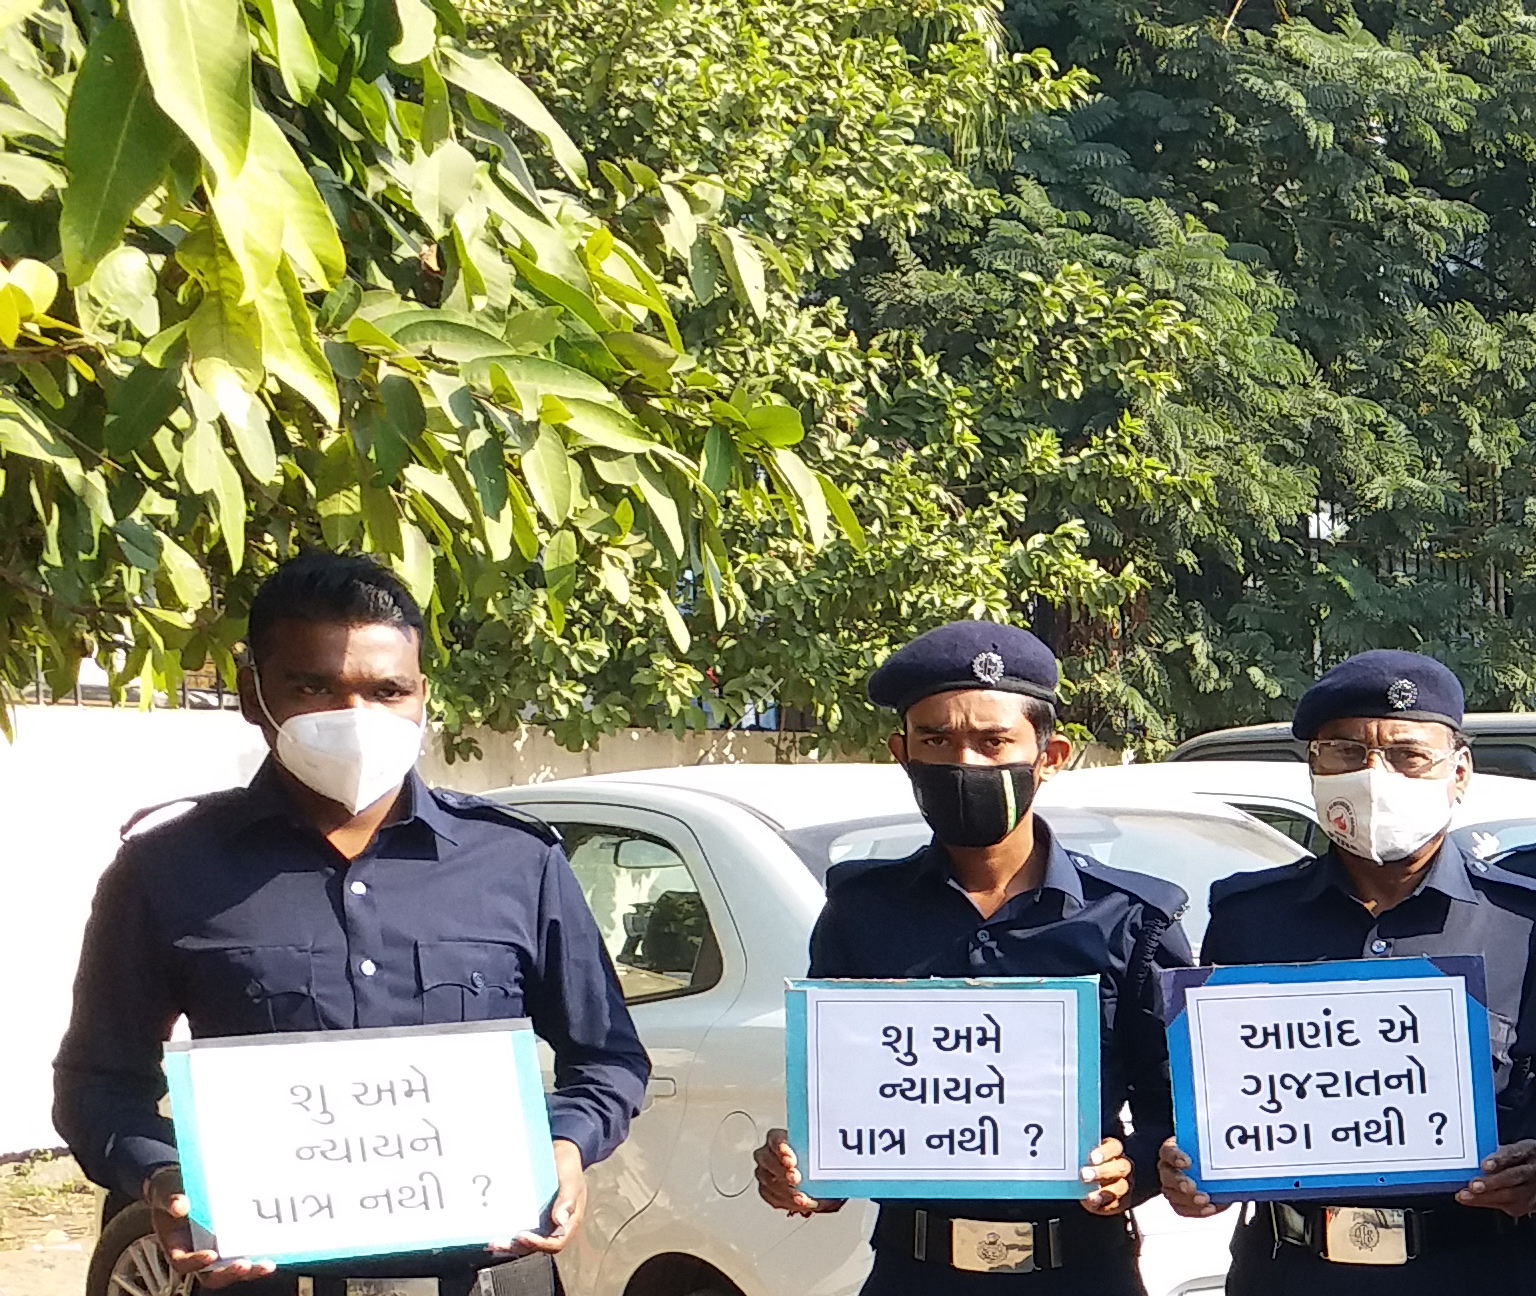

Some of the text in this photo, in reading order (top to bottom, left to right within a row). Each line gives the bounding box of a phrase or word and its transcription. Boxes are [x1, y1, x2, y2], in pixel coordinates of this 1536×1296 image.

[882, 1014, 1000, 1066] શુ અમે
[1241, 1005, 1418, 1049] આણંદ એ
[291, 1065, 430, 1124] શુ અમે
[880, 1063, 1004, 1104] ન્યાયને
[1241, 1056, 1426, 1115] ગુજરાતનો
[296, 1116, 442, 1163] ન્યાયને
[839, 1116, 1043, 1157] પાત્ર નથી ?
[1226, 1107, 1447, 1151] ભાગ નથી ?
[253, 1172, 491, 1223] પાત્ર નથી ?
